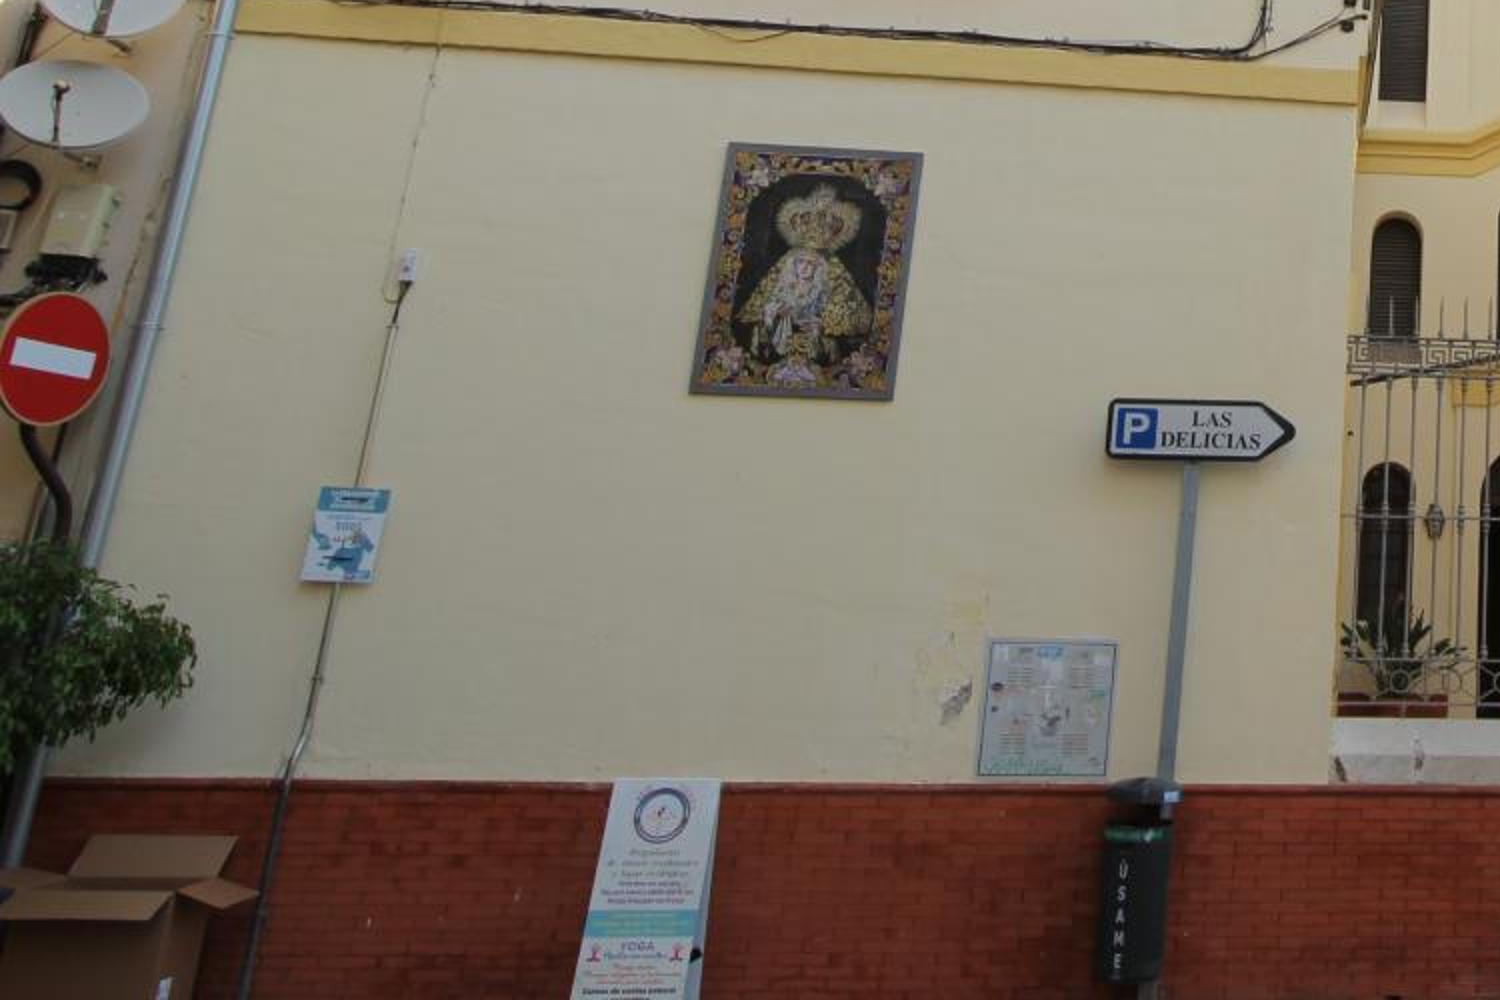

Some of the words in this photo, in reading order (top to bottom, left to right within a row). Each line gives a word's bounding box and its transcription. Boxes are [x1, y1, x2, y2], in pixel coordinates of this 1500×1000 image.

[1122, 411, 1150, 445] P
[1191, 410, 1232, 428] LAS
[1160, 431, 1262, 449] DELICIAS
